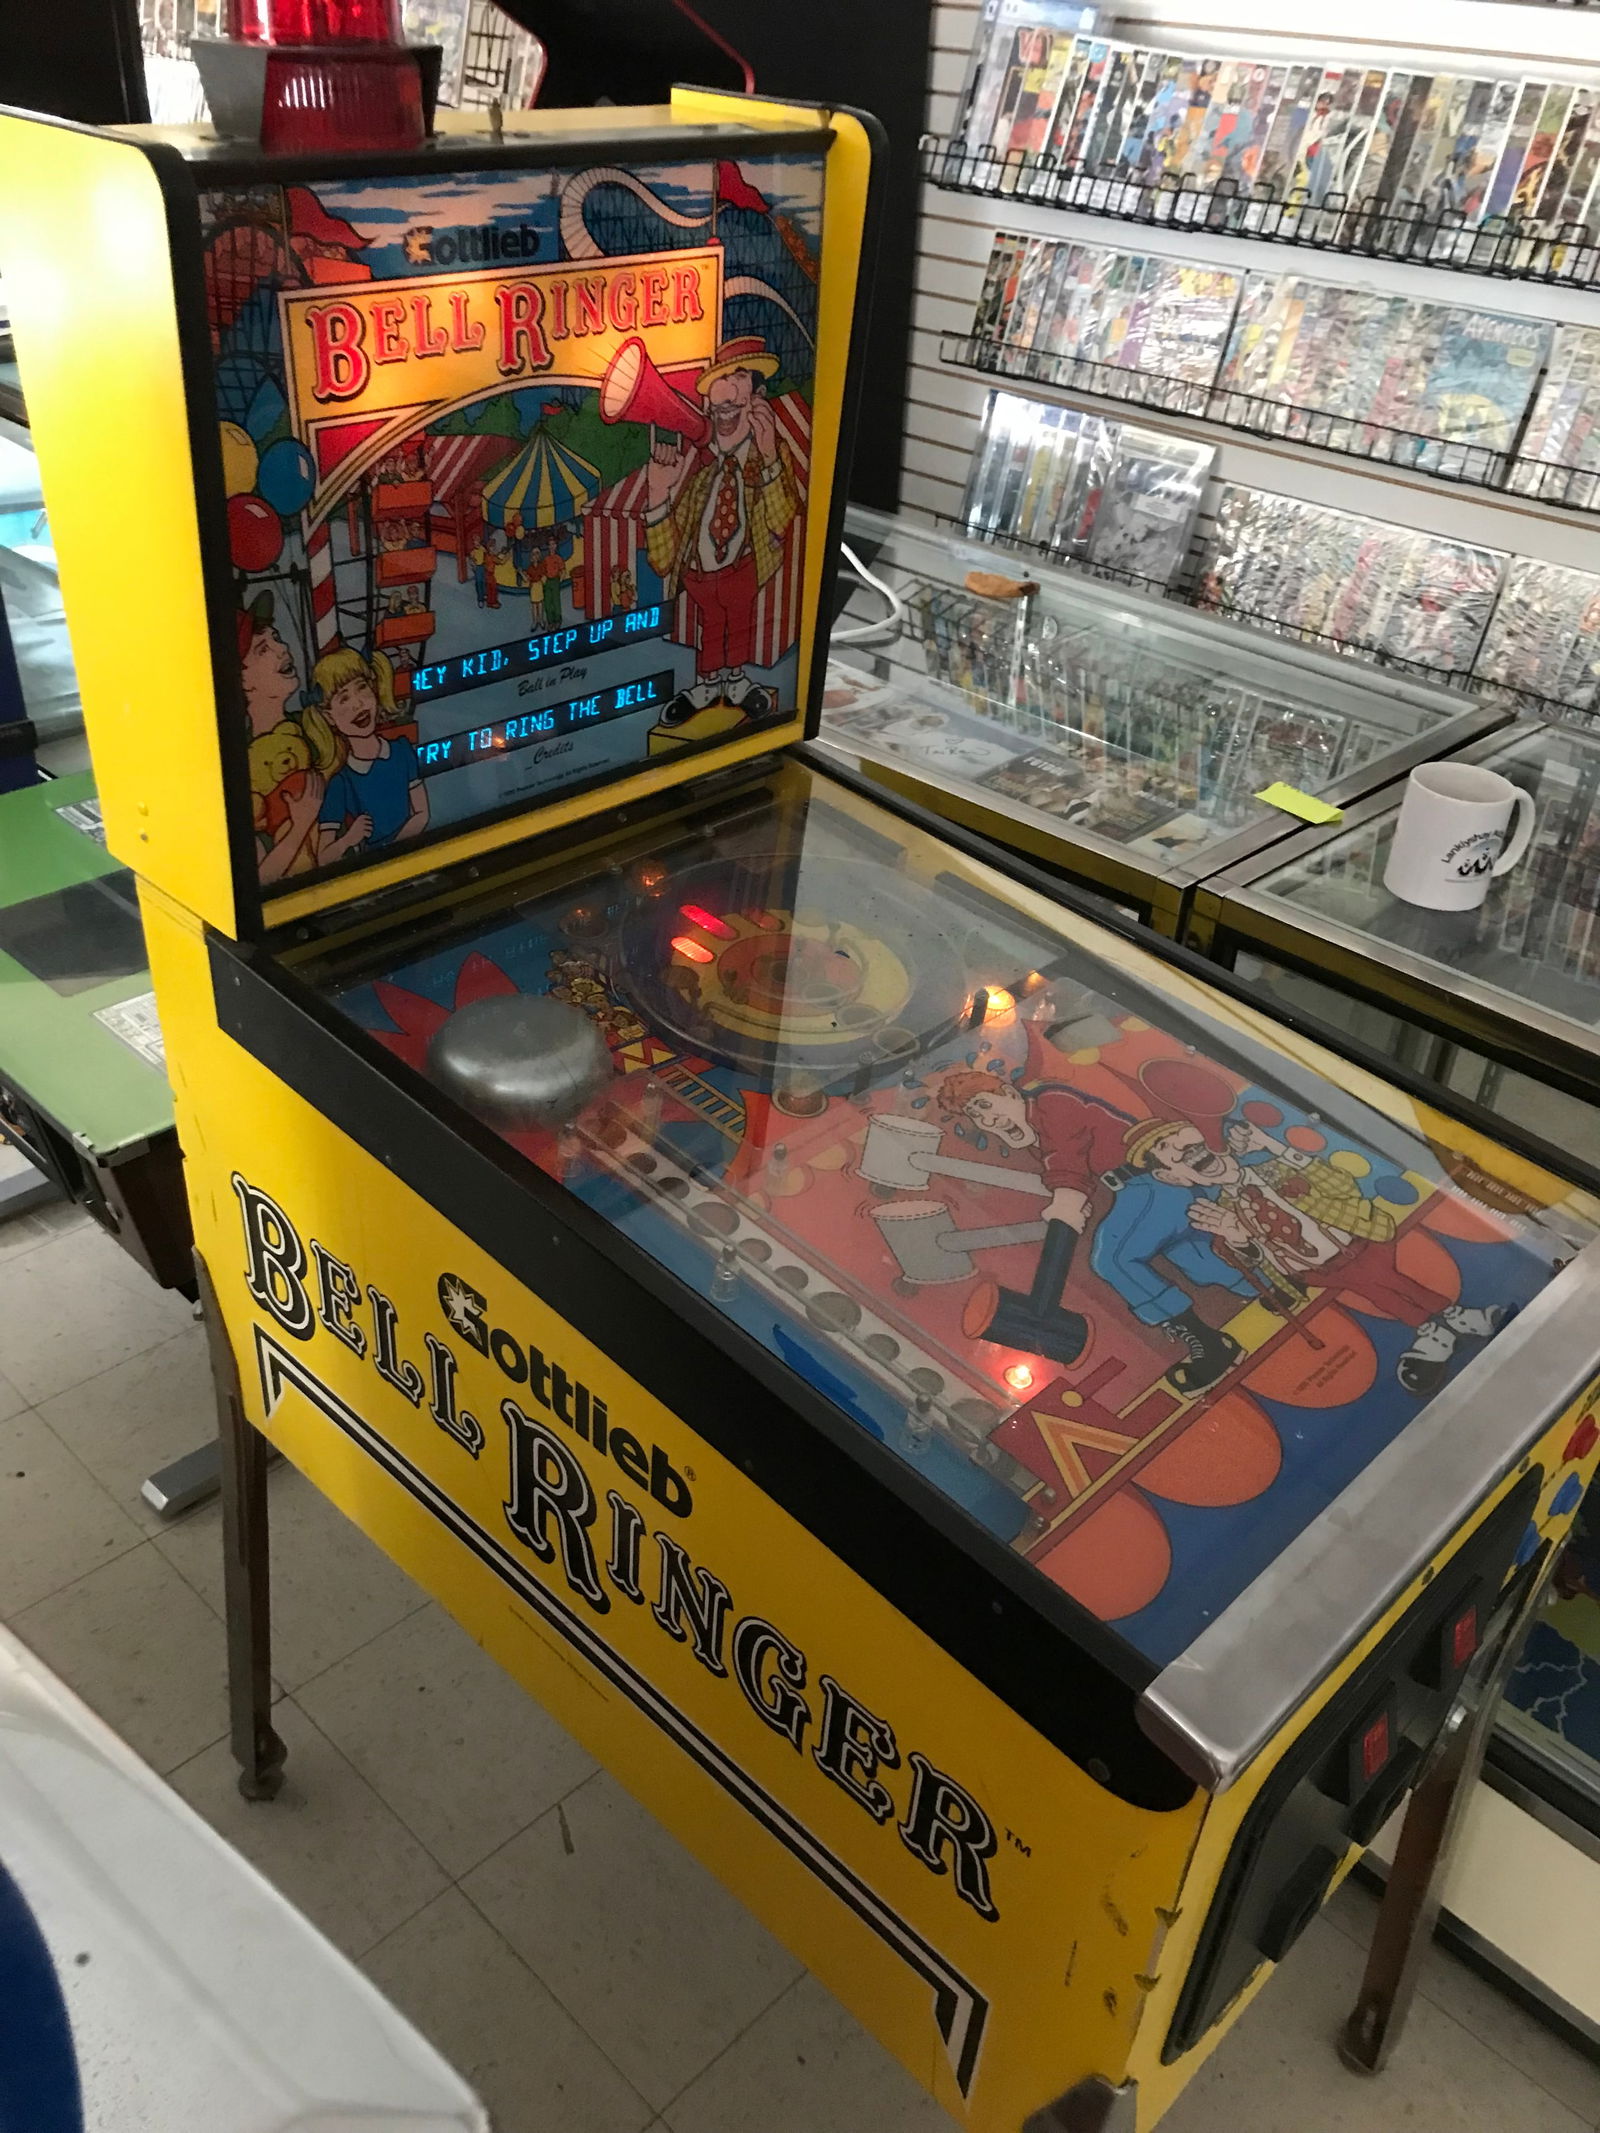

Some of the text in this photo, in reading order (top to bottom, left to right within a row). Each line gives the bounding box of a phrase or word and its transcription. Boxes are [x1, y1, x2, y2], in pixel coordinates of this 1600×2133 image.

[403, 224, 540, 266] Gottlieb
[306, 265, 704, 404] BELL RINGER
[528, 629, 577, 661] STEP
[589, 620, 613, 645] UP
[625, 606, 660, 633] AND
[517, 677, 543, 697] Ball
[559, 665, 588, 682] Play
[469, 727, 492, 751] TO
[505, 709, 555, 740] RING
[569, 695, 602, 721] THE
[615, 680, 657, 710] BELL
[231, 1171, 485, 1461] BELL
[500, 1397, 1000, 1923] RINGER
